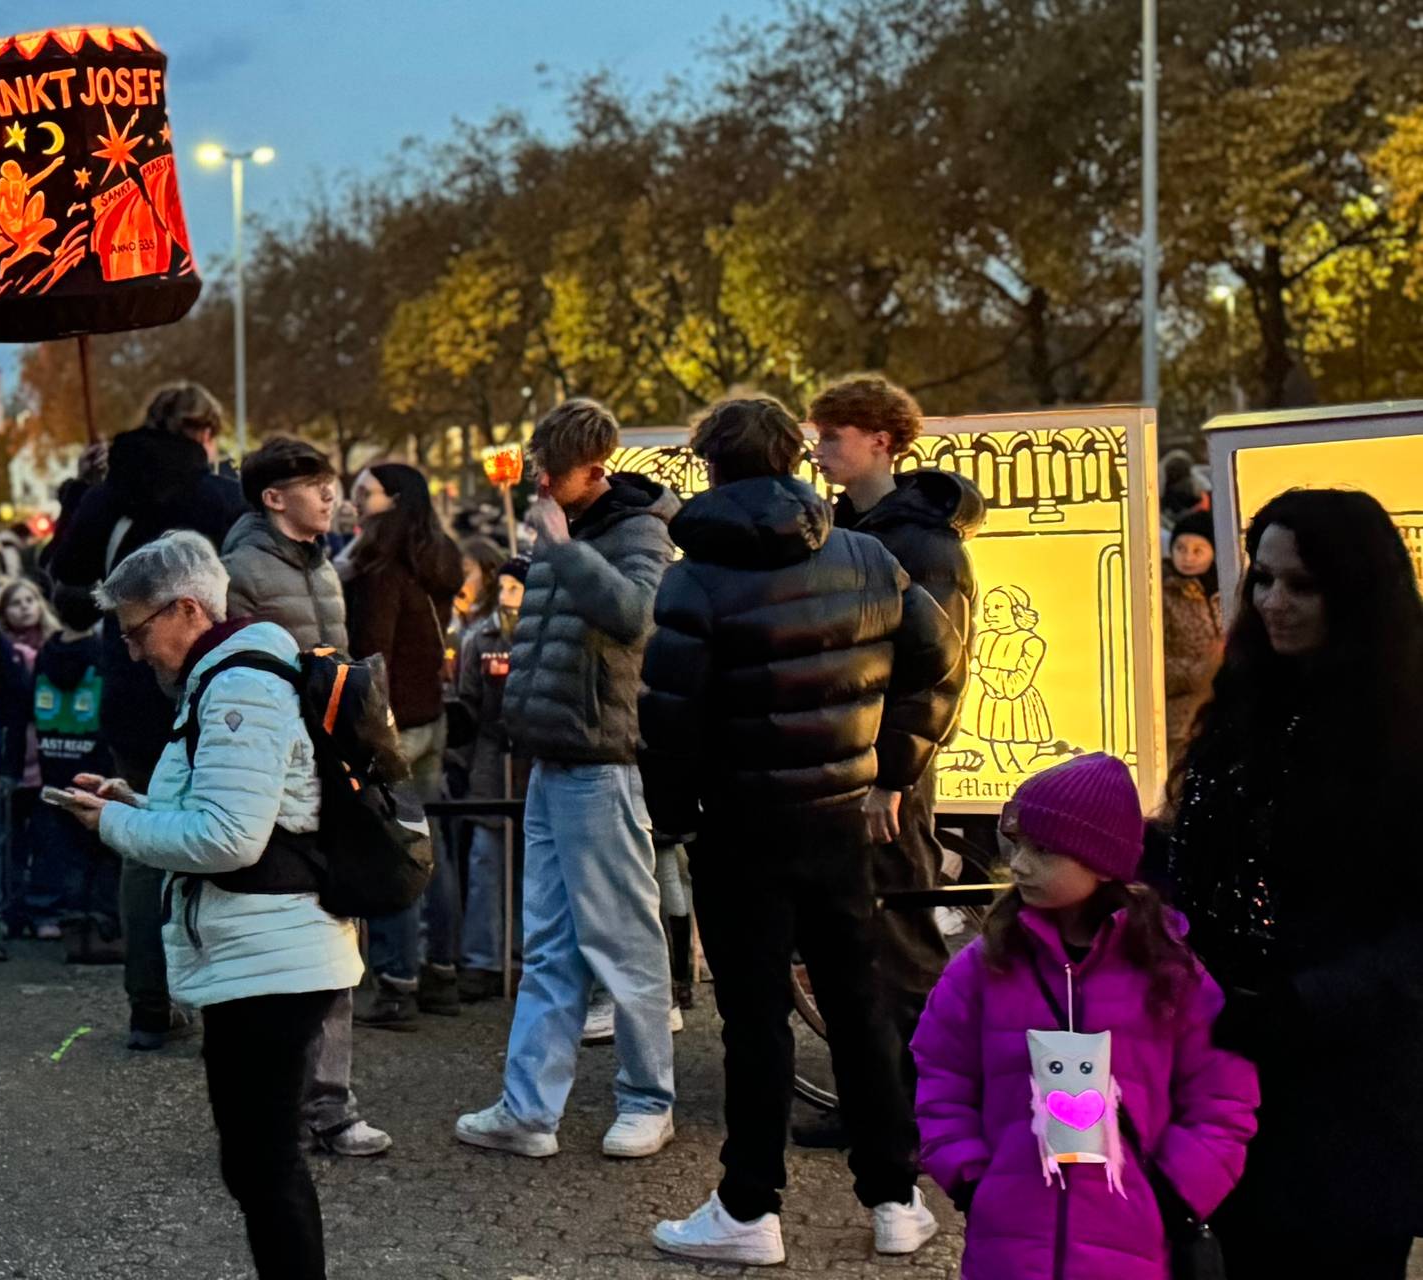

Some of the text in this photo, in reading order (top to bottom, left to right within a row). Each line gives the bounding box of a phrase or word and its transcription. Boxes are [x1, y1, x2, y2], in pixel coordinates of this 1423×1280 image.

[80, 67, 161, 106] JOSEF
[100, 182, 131, 207] SANKT
[955, 778, 1017, 798] Mart
